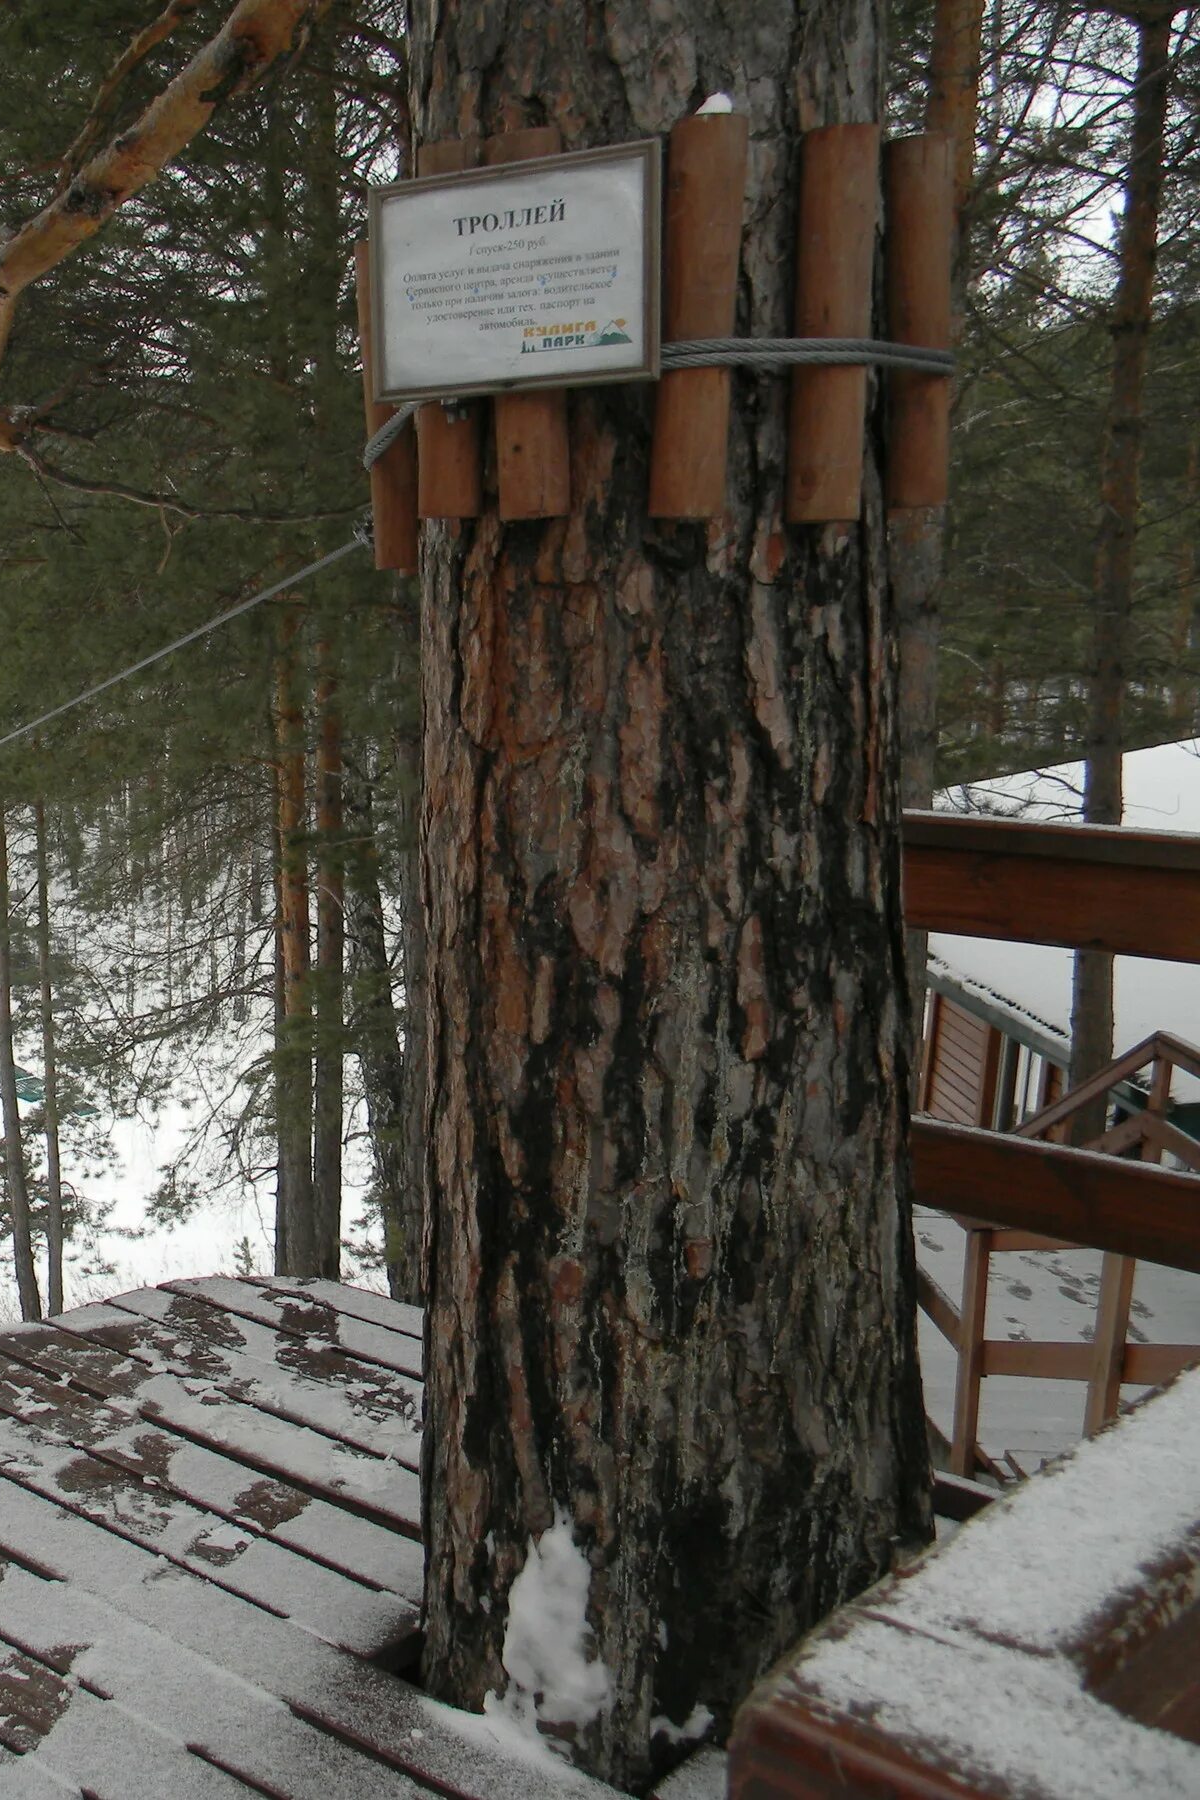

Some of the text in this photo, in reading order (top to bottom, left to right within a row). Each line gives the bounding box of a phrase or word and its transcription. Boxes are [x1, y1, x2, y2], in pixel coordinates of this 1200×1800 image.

[453, 198, 566, 236] ТРОЛЛЕЙ
[403, 270, 437, 283] Оплата
[438, 267, 464, 280] услуг
[467, 265, 474, 273] и
[476, 261, 511, 274] выдача
[513, 255, 573, 270] снаряжения
[584, 247, 620, 263] здании
[405, 281, 461, 297] Сервисного
[500, 273, 533, 286] аренда
[536, 263, 617, 282] осуществляется
[411, 298, 443, 310] только
[445, 297, 462, 307] при
[464, 290, 504, 303] наличии
[543, 279, 613, 296] водительское
[425, 305, 495, 325] удостоверение
[497, 303, 515, 314] или
[539, 298, 582, 314] паспорт
[584, 297, 595, 306] на
[523, 319, 597, 338] КУЛИГА
[542, 335, 586, 348] ПАРК
